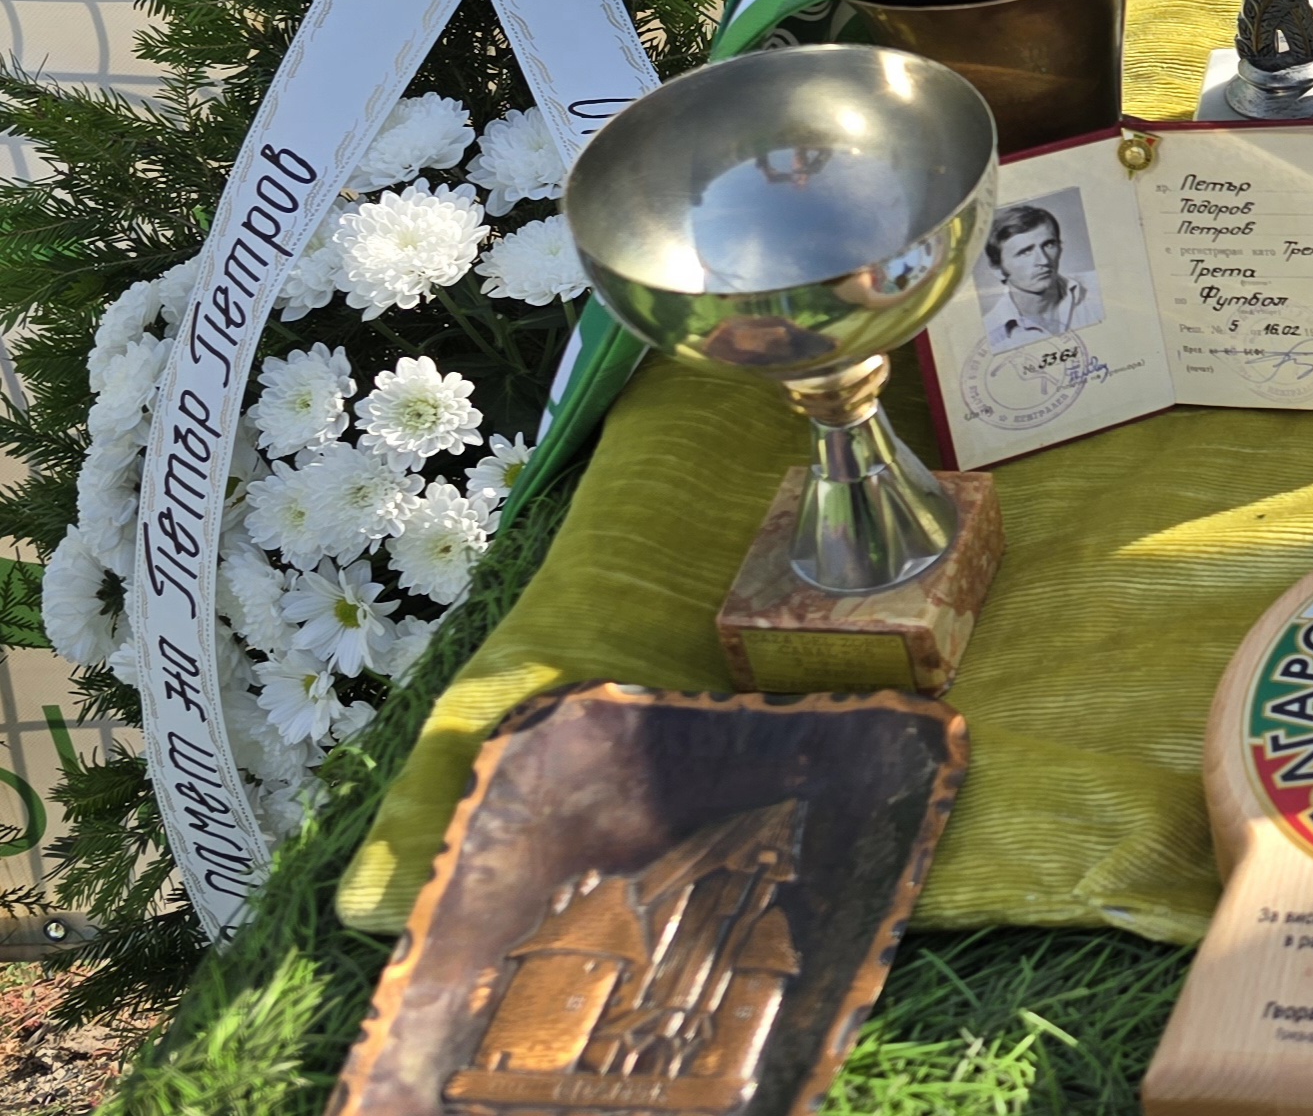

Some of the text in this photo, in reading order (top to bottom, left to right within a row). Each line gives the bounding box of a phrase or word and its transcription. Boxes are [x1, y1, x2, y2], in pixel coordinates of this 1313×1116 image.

[1180, 174, 1252, 197] Петър
[1179, 198, 1255, 221] Тодоров
[1177, 220, 1256, 243] Петров
[1180, 246, 1244, 259] регистриран
[1252, 248, 1276, 257] като
[190, 143, 317, 388] Петров
[1189, 259, 1256, 284] Трета
[1199, 285, 1289, 312] Футбол
[1228, 319, 1239, 333] 5
[142, 389, 222, 620] Петър
[158, 634, 207, 724] на
[1258, 907, 1278, 923] За
[1285, 935, 1294, 947] в
